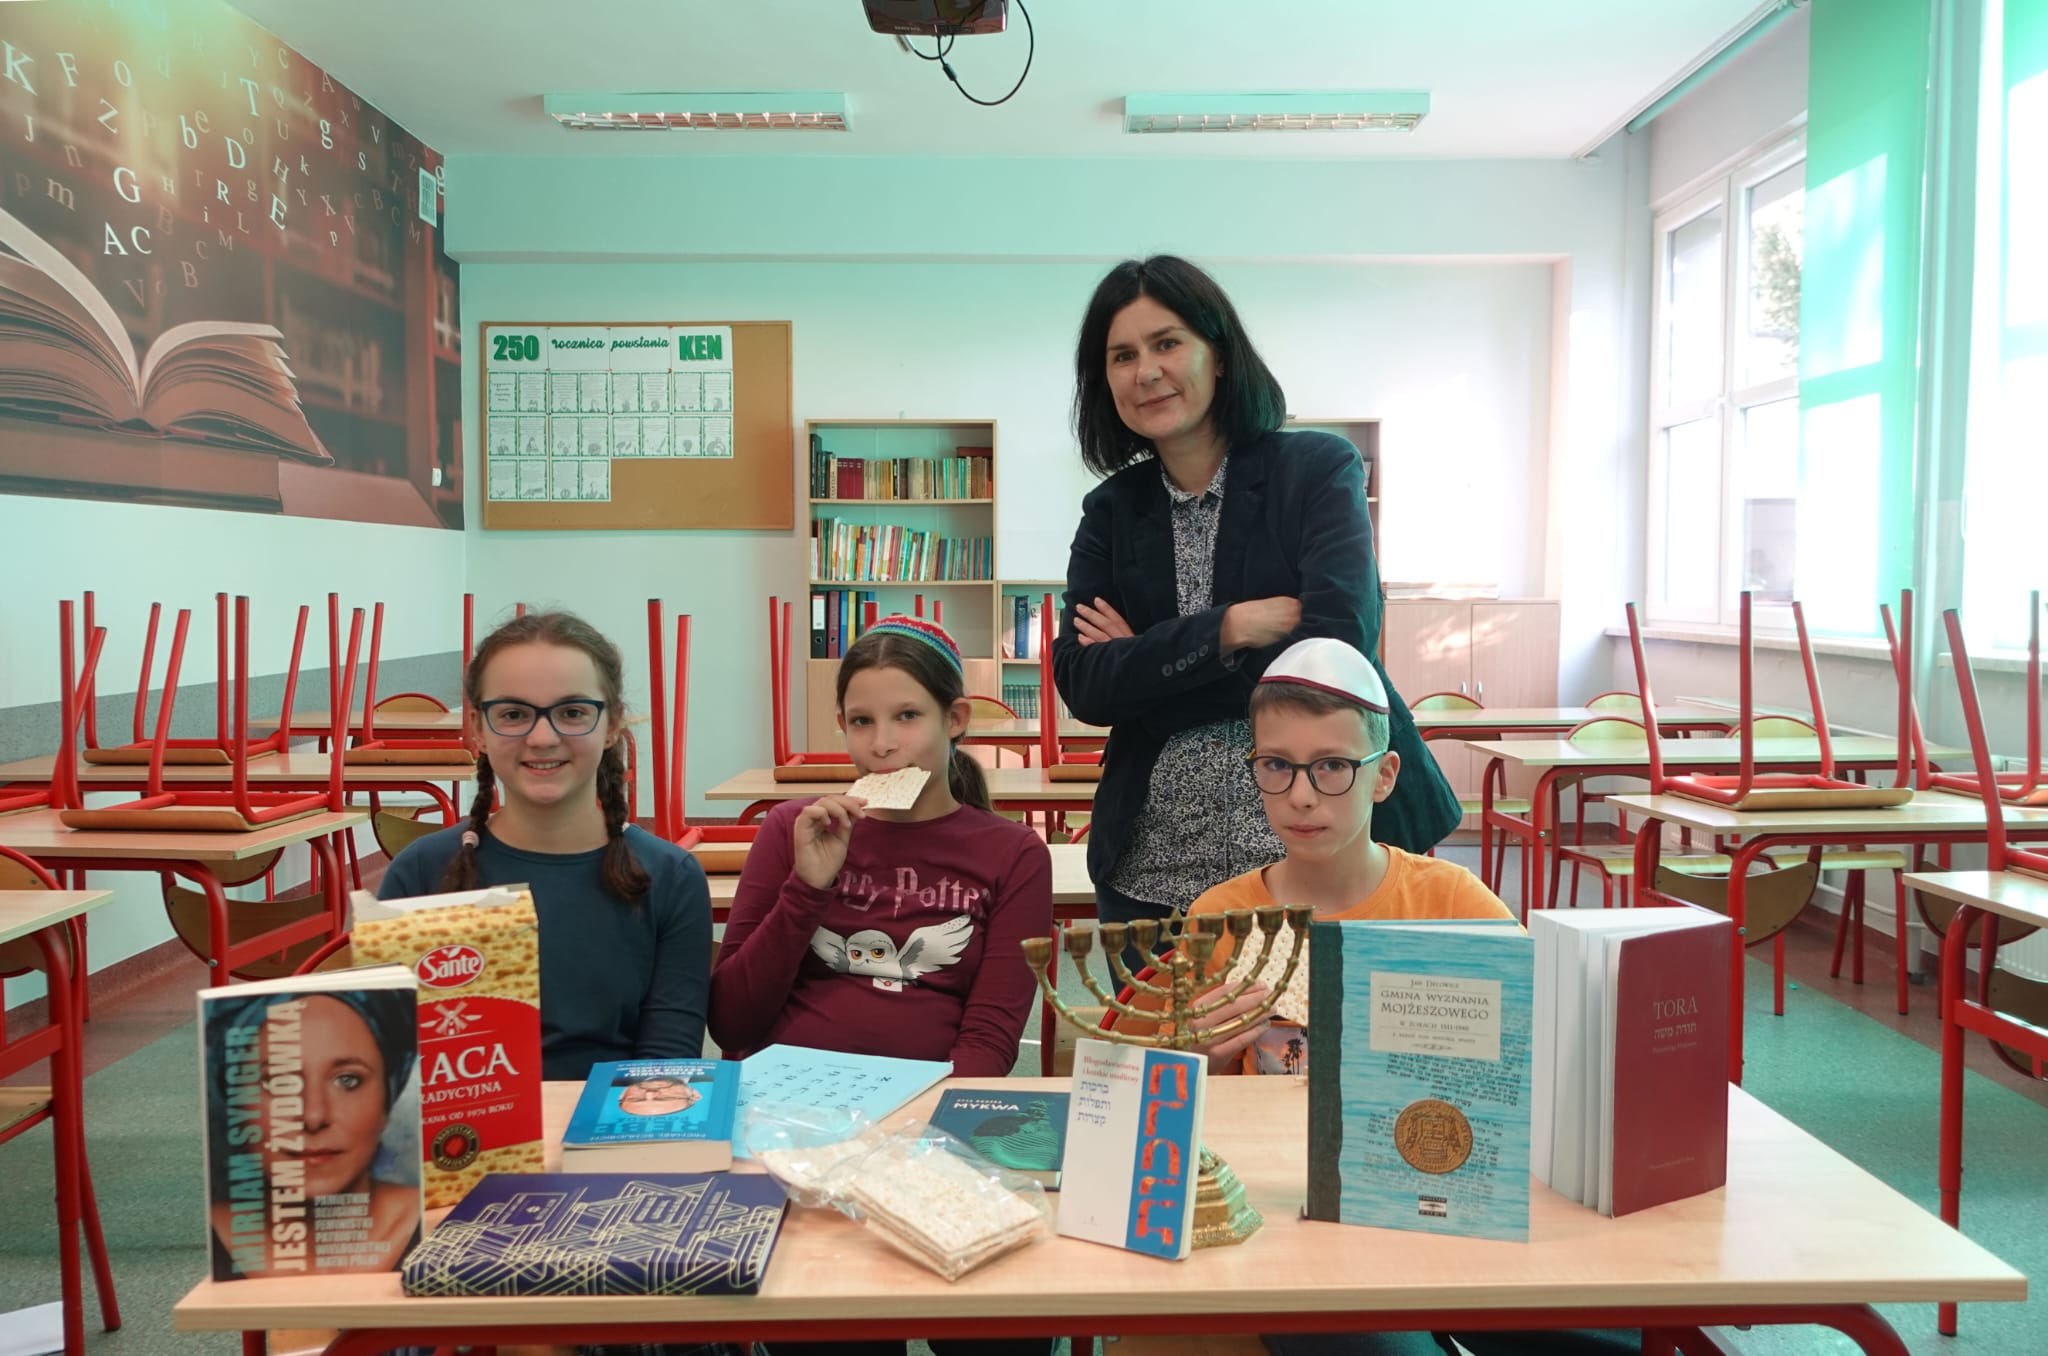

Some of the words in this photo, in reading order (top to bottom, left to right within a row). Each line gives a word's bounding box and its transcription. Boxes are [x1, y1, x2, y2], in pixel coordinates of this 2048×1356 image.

[1, 39, 39, 96] K
[56, 52, 79, 88] F
[239, 77, 260, 117] T
[178, 114, 198, 149] b
[319, 119, 334, 150] g
[223, 135, 247, 169] D
[272, 155, 290, 184] H
[47, 177, 76, 211] m
[112, 166, 142, 203] G
[215, 178, 231, 206] R
[269, 192, 288, 231] E
[492, 335, 541, 362] 250
[551, 337, 606, 350] rocznica
[610, 335, 670, 352] powstania
[678, 335, 724, 361] KEN
[839, 869, 889, 911] rry
[421, 953, 481, 984] Sante
[1380, 989, 1422, 1001] GMINA
[1426, 993, 1490, 1006] WYZNANIA
[1380, 1001, 1490, 1021] MOJŻESZOWEGO
[1652, 994, 1699, 1020] TORA
[262, 1000, 308, 1153] ŻYDÓWKĄ
[418, 1041, 520, 1087] ACA
[224, 1024, 264, 1147] SYNGER
[952, 1102, 1020, 1111] MYKWA
[227, 1152, 267, 1275] MIRIAM
[270, 1160, 308, 1272] JESTEM
